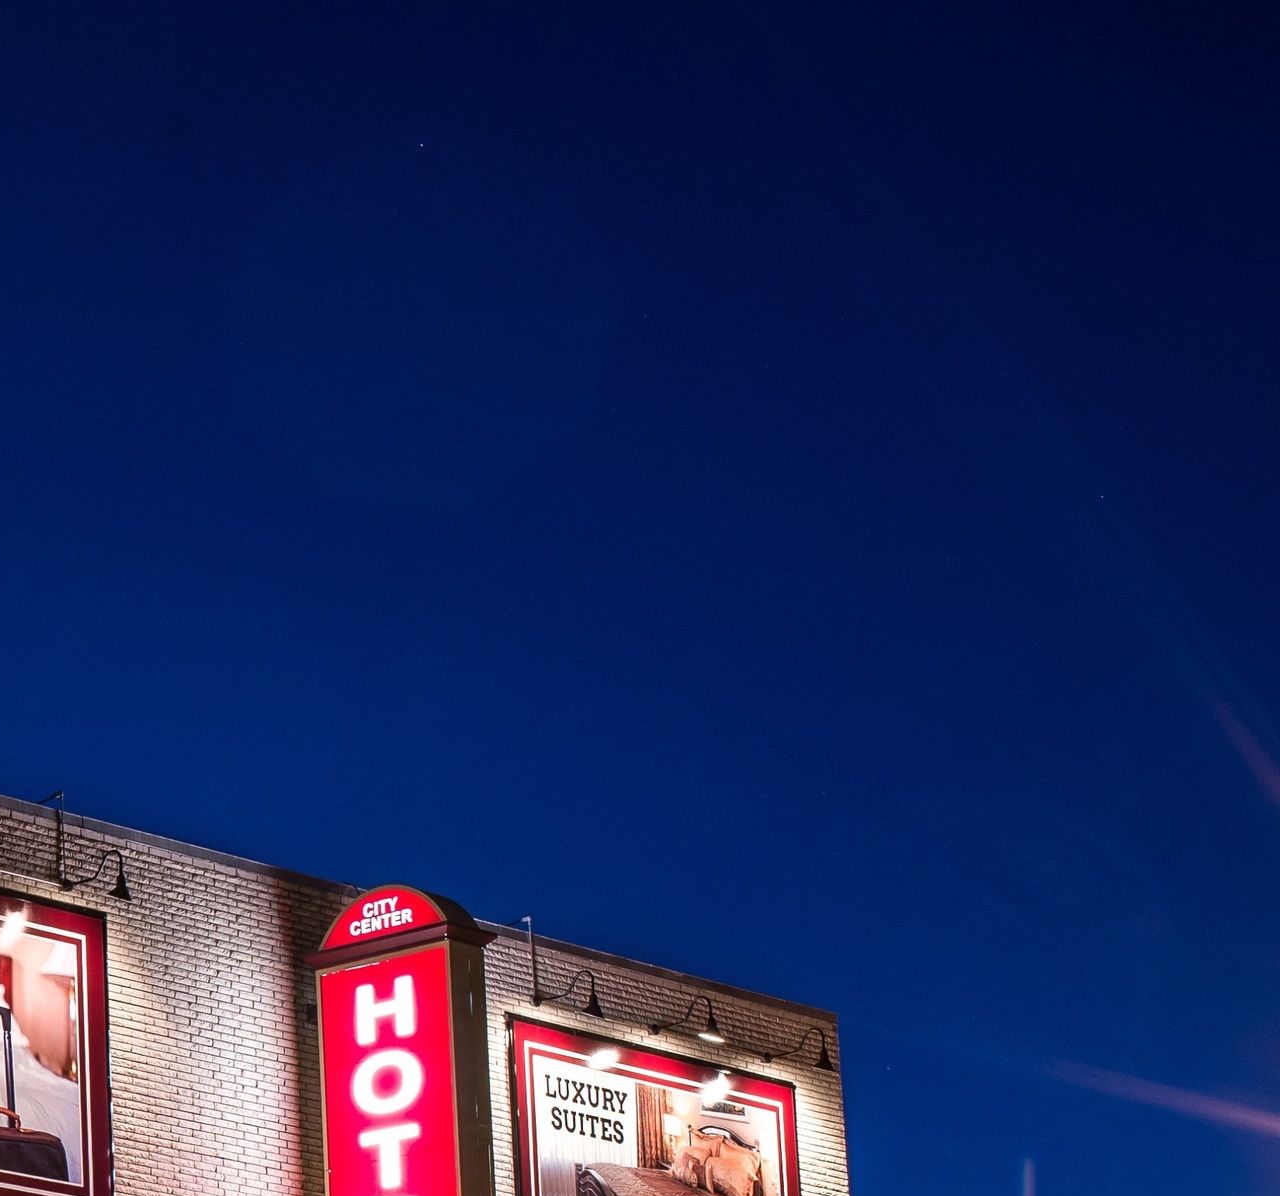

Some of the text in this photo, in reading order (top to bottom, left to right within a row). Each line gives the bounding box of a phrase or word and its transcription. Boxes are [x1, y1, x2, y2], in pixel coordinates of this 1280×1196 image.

[349, 908, 413, 936] CENTER
[362, 896, 398, 918] CITY
[545, 1074, 627, 1114] LUXURY
[551, 1106, 624, 1144] SUITES
